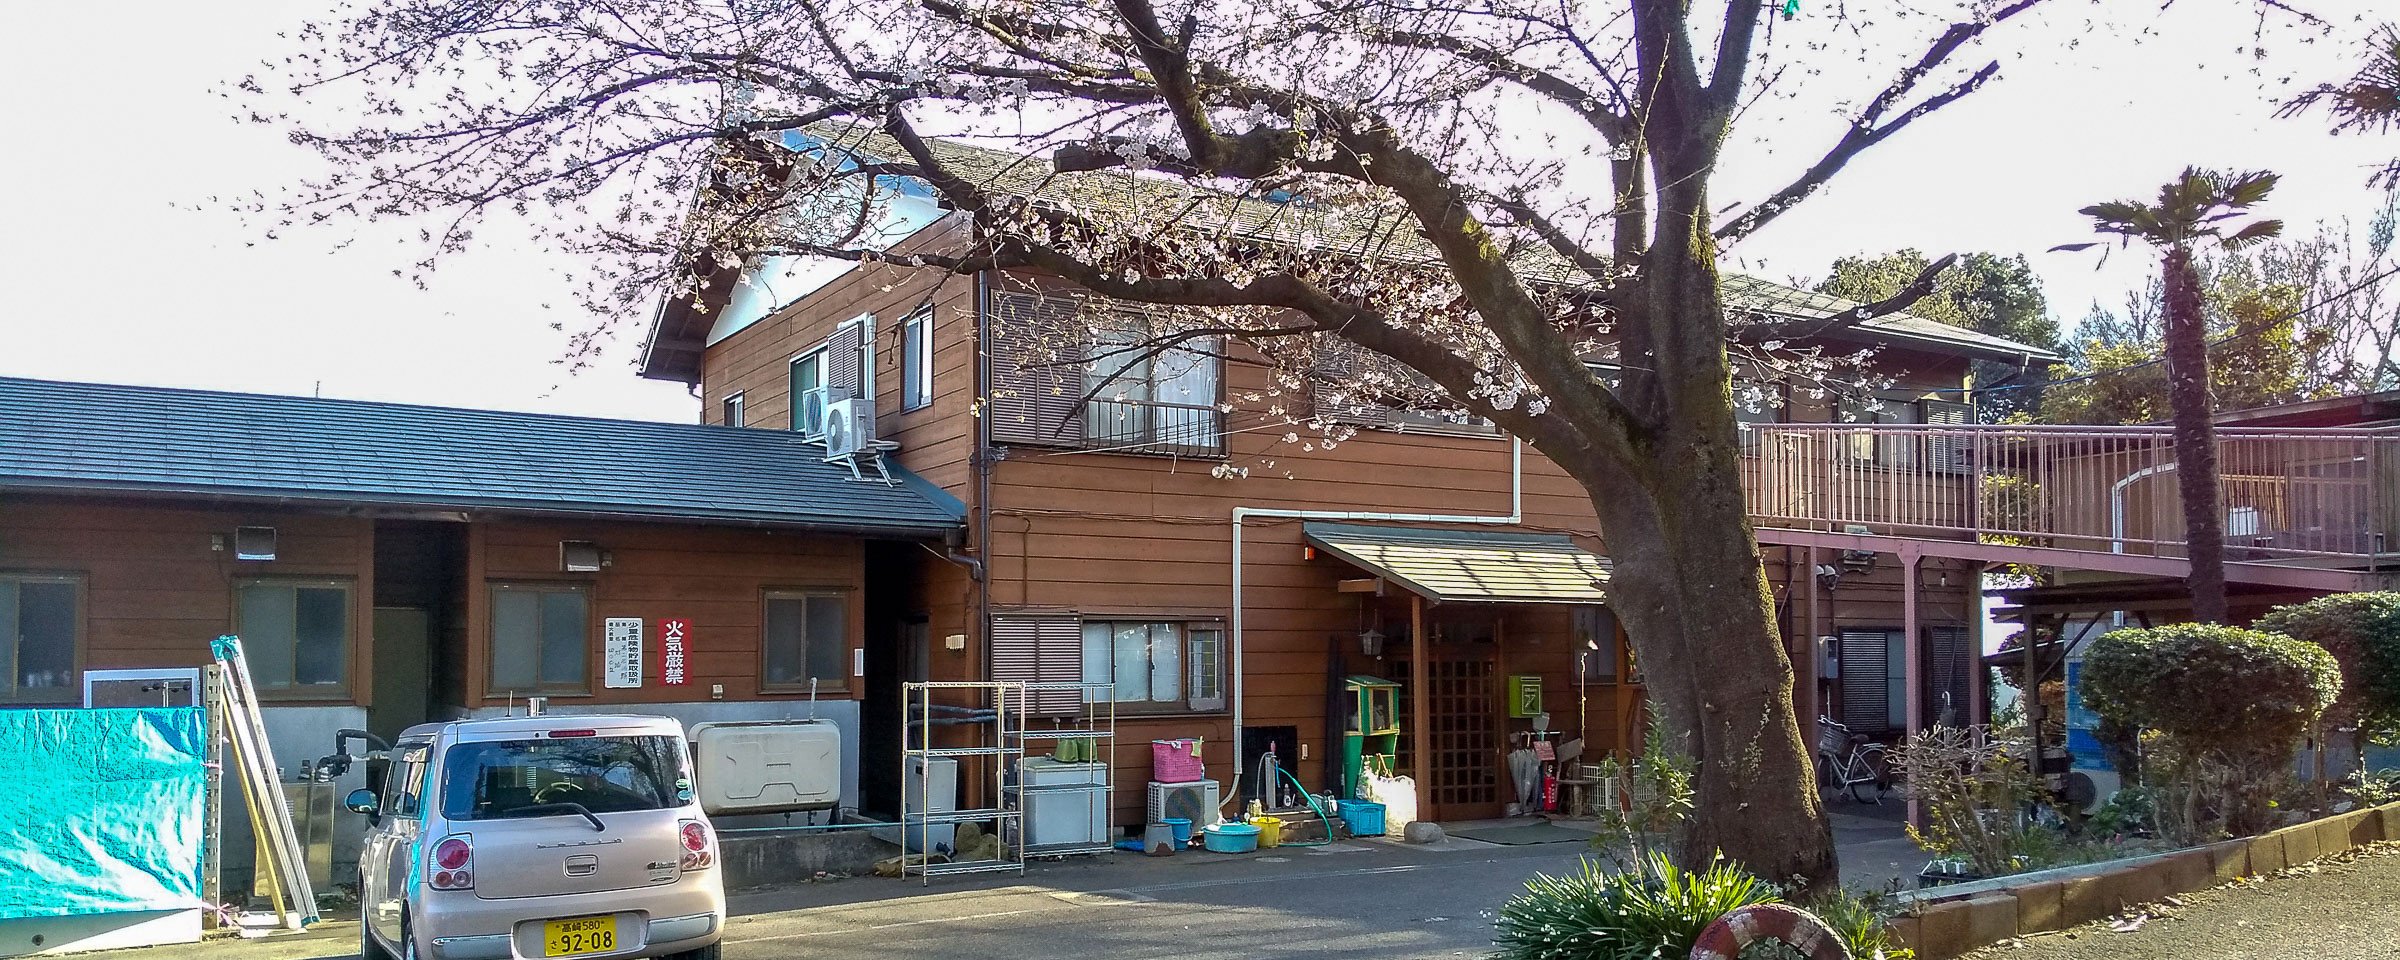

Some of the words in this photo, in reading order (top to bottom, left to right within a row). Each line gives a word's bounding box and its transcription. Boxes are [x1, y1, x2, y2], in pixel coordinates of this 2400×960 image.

[628, 621, 639, 684] 少量危険物貯蔵取扱所
[665, 620, 684, 685] 火気厳禁
[551, 940, 557, 950] さ
[561, 930, 613, 953] 92-08
[562, 923, 582, 932] 高崎
[582, 920, 600, 930] 580
